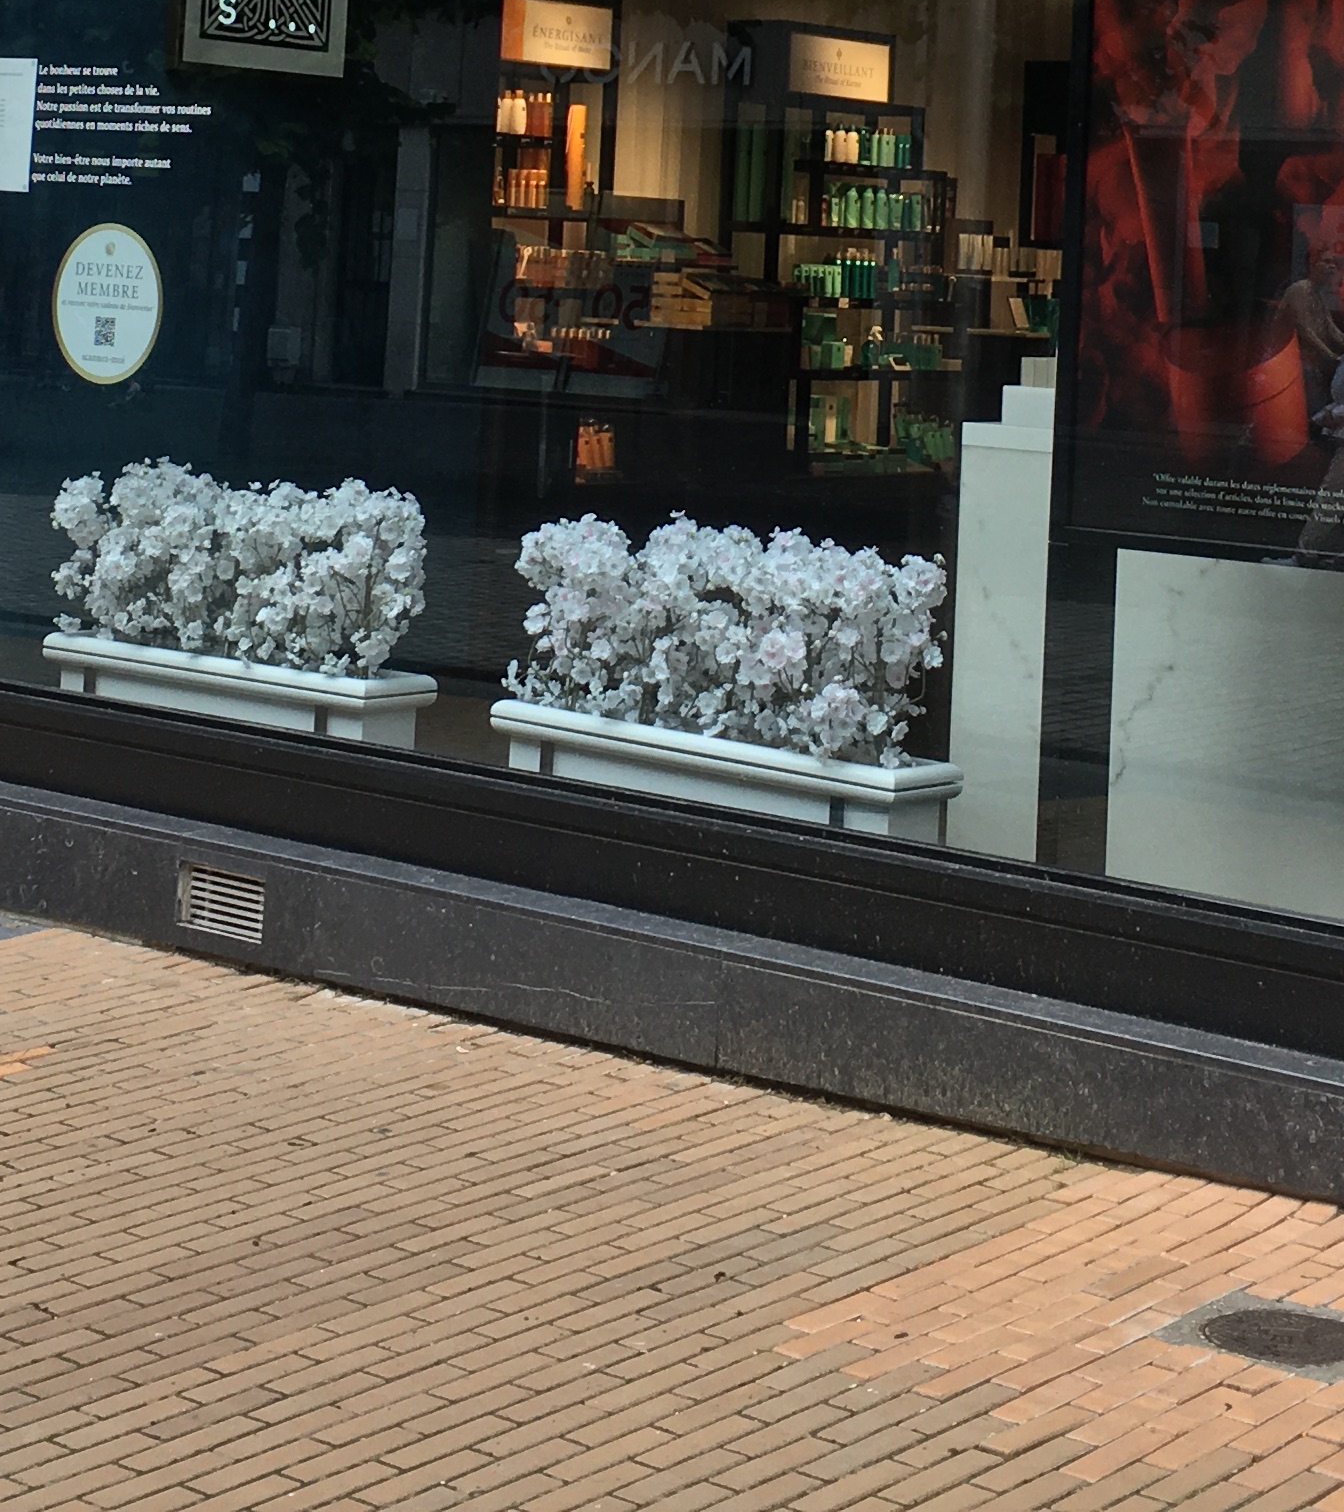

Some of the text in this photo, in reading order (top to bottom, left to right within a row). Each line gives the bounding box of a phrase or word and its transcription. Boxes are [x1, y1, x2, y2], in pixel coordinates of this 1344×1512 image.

[38, 64, 118, 76] Le bonheur se trouve
[38, 82, 159, 97] dans les petites choses de la vie.
[36, 100, 212, 115] Notre passion est de transformer vos routines
[35, 118, 193, 133] quotidiennes en moments riches de sens.
[33, 152, 171, 169] Votre bien-être nous importe autant
[31, 172, 46, 183] que
[46, 171, 66, 182] celui
[67, 172, 77, 183] de
[77, 174, 99, 184] notre
[75, 261, 144, 280] DEVENEZ
[76, 281, 139, 299] MEMBRE
